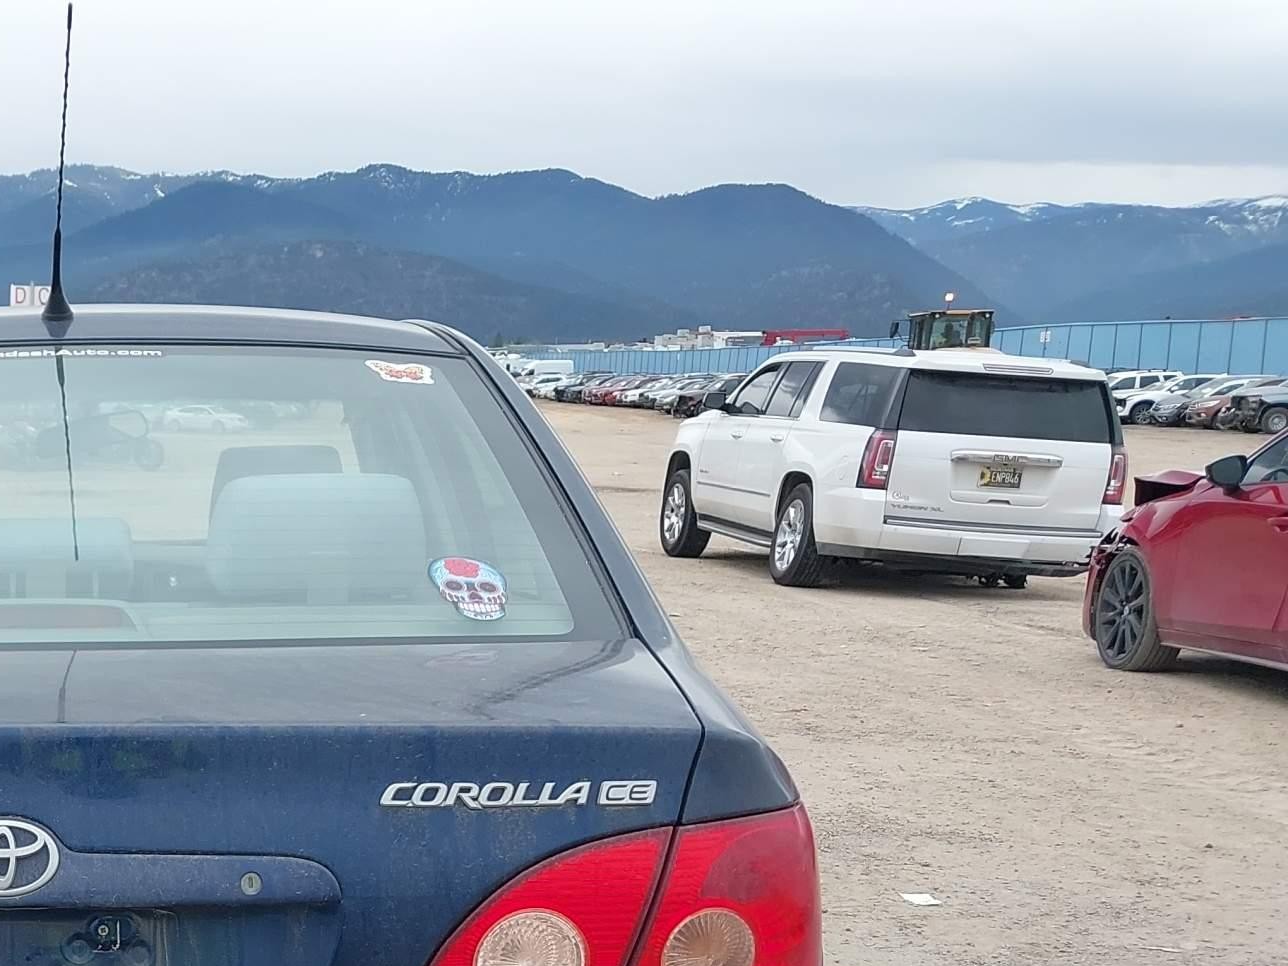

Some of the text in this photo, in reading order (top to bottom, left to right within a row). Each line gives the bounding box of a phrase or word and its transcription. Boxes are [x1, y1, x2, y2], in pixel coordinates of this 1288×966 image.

[15, 287, 26, 304] D
[379, 780, 653, 809] COROLLA CE
